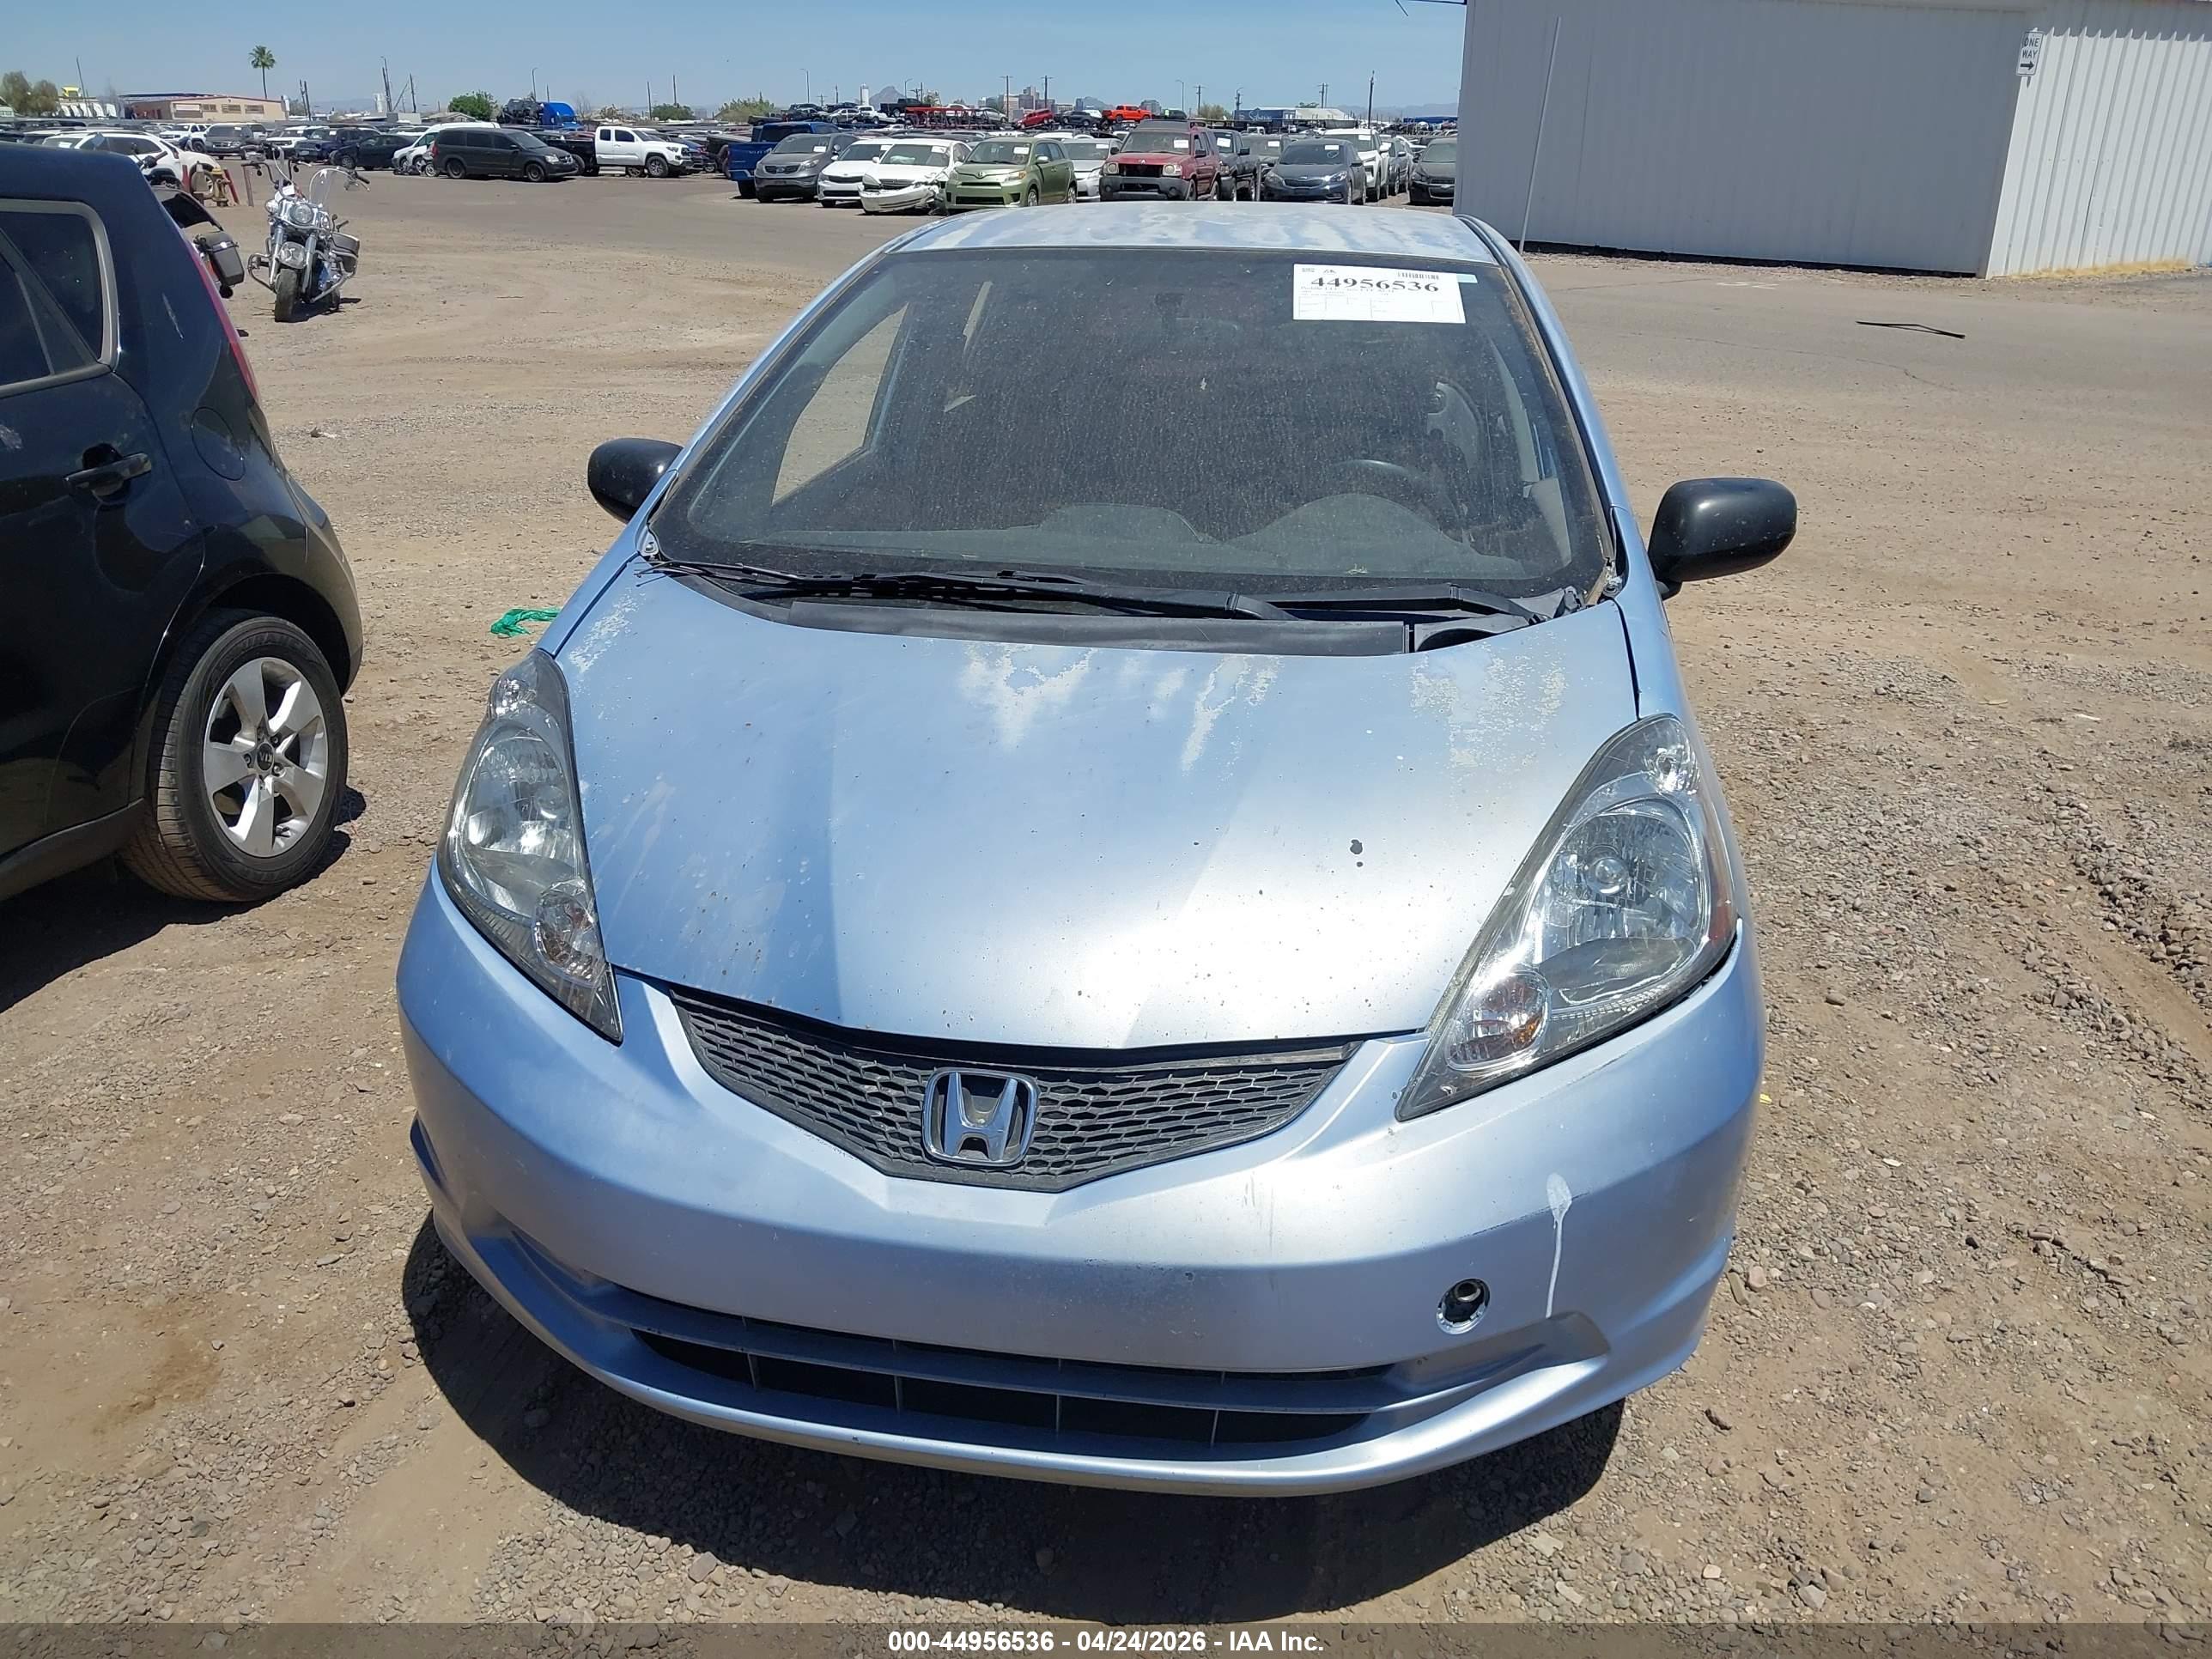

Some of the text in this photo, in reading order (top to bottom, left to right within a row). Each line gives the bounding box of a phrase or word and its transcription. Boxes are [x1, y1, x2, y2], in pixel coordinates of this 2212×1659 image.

[2024, 37, 2040, 47] ONE
[2021, 49, 2039, 58] WAY
[1310, 276, 1439, 293] 44956536
